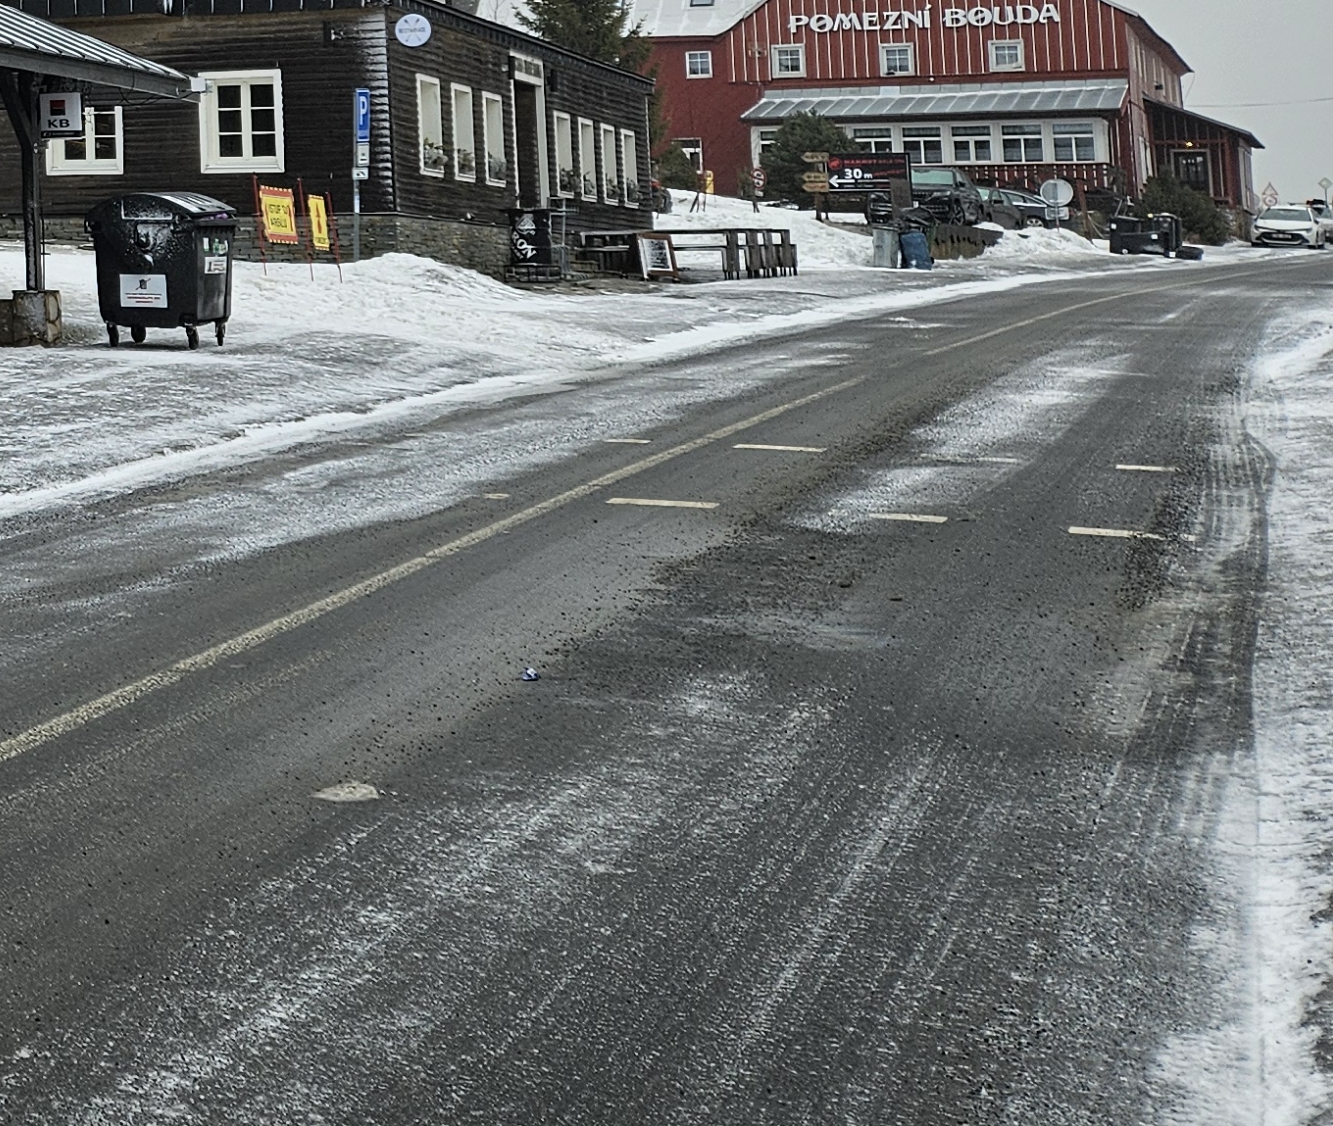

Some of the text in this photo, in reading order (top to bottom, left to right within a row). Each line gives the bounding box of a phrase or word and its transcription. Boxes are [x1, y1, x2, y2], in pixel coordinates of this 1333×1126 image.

[788, 4, 1060, 34] POMEZNÍ BOUDA
[359, 95, 368, 126] P
[47, 119, 70, 129] KB
[844, 168, 863, 179] 30
